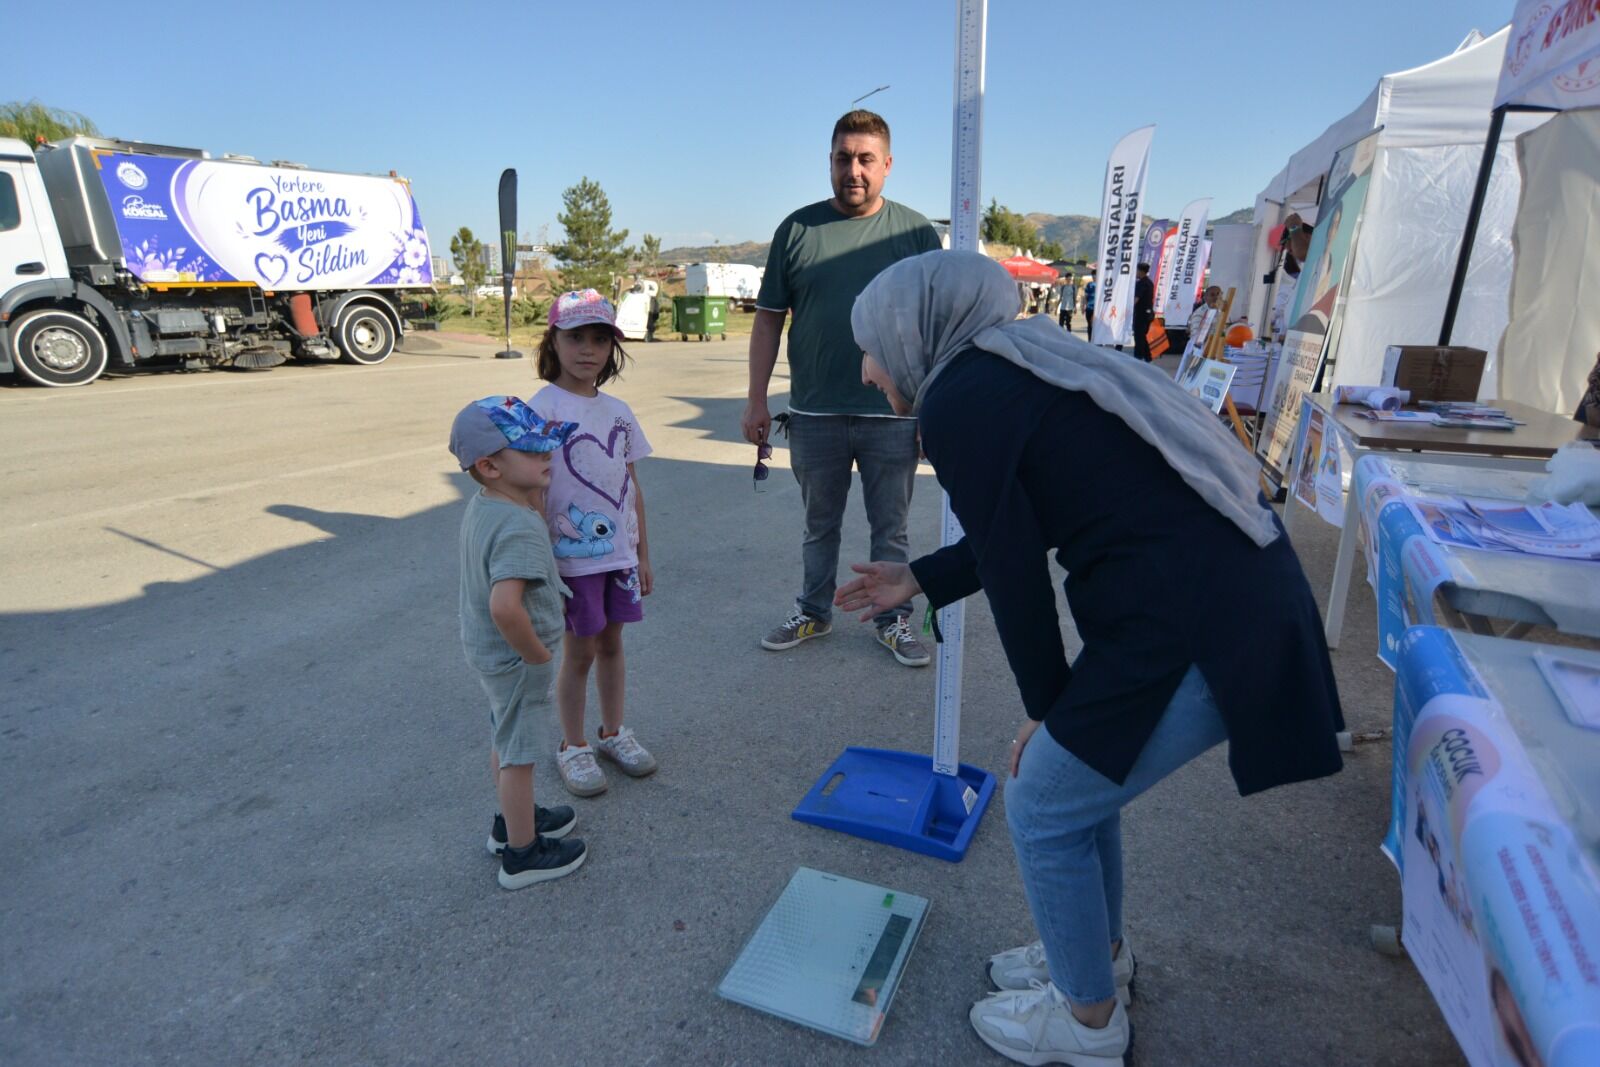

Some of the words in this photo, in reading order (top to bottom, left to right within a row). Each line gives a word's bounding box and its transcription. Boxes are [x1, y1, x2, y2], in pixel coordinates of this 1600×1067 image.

[270, 175, 325, 194] Yerlere
[245, 187, 351, 237] Basma
[297, 223, 327, 247] Yeni
[1105, 165, 1125, 271] HASTALARI
[1120, 191, 1139, 275] DERNEĞİ
[296, 244, 369, 283] Sildim
[1174, 218, 1192, 281] HASTALARI
